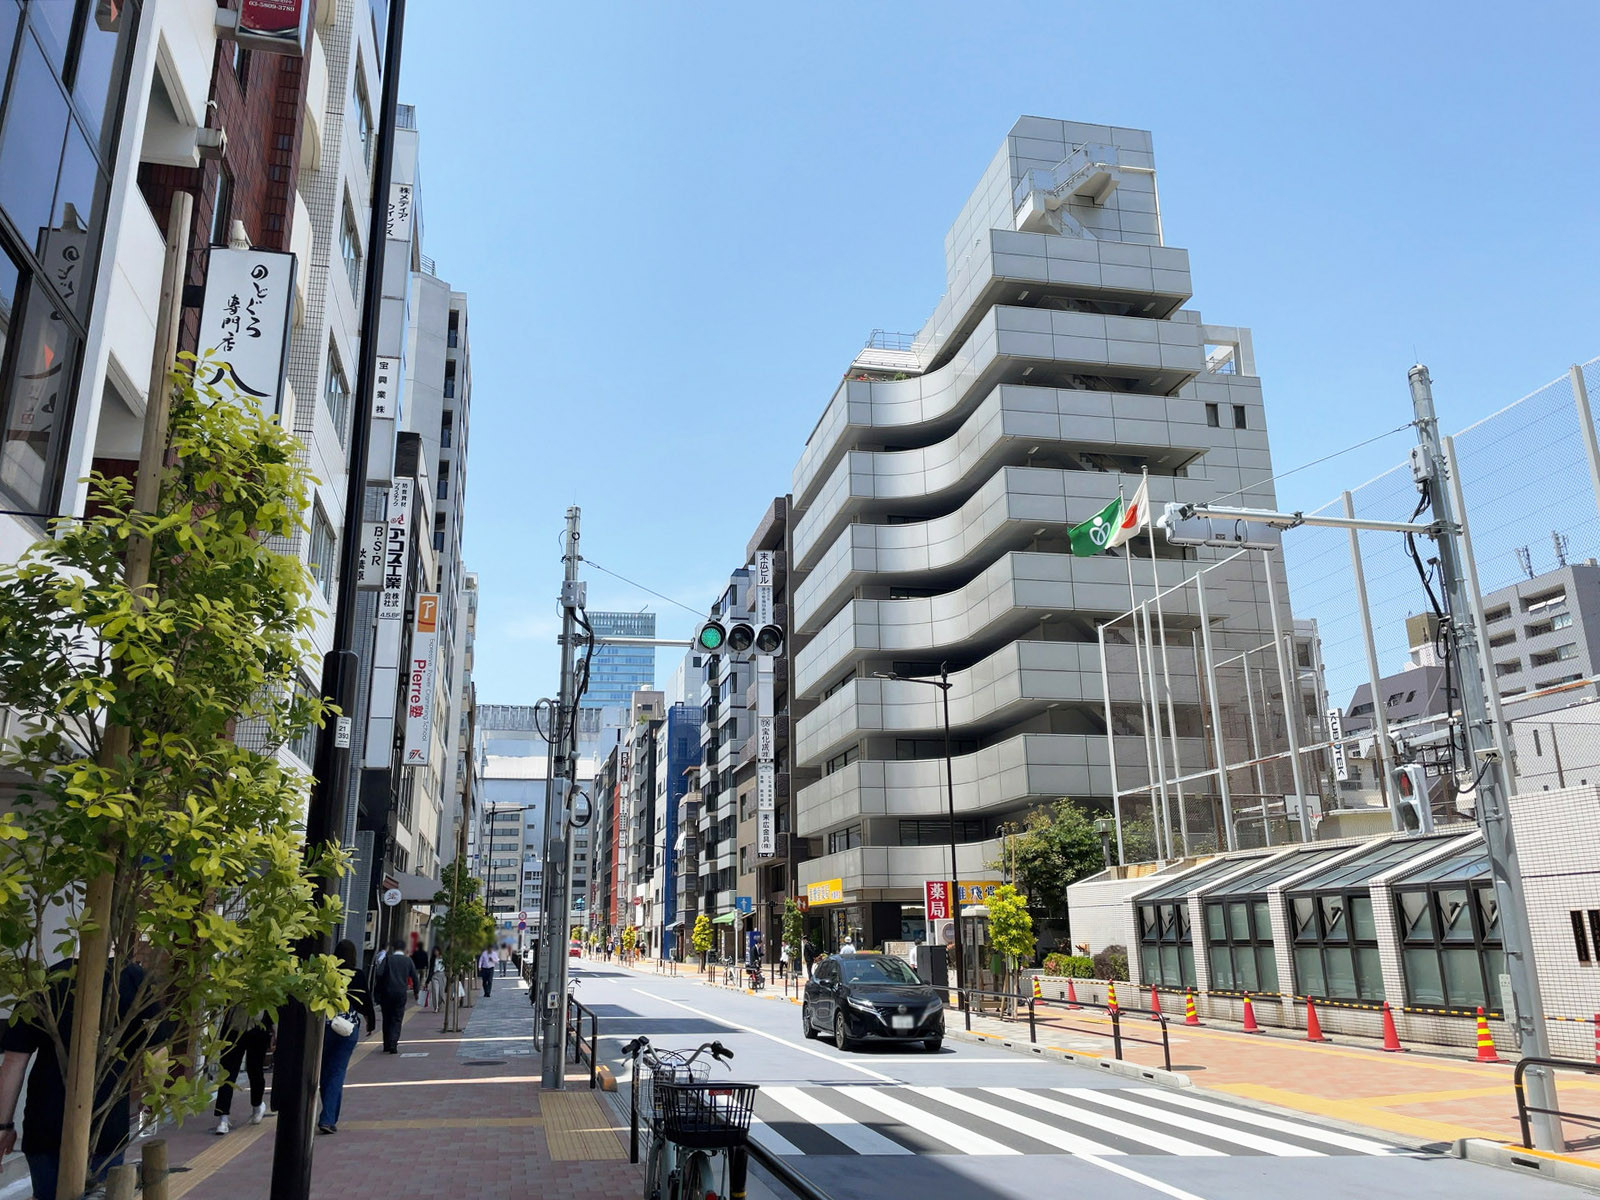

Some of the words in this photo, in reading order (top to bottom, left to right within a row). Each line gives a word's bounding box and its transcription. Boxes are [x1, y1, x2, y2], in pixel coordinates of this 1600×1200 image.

[246, 264, 269, 338] のどぐろ
[385, 527, 405, 589] アコス工業
[760, 552, 769, 584] 末広ビル
[930, 883, 945, 918] 薬局
